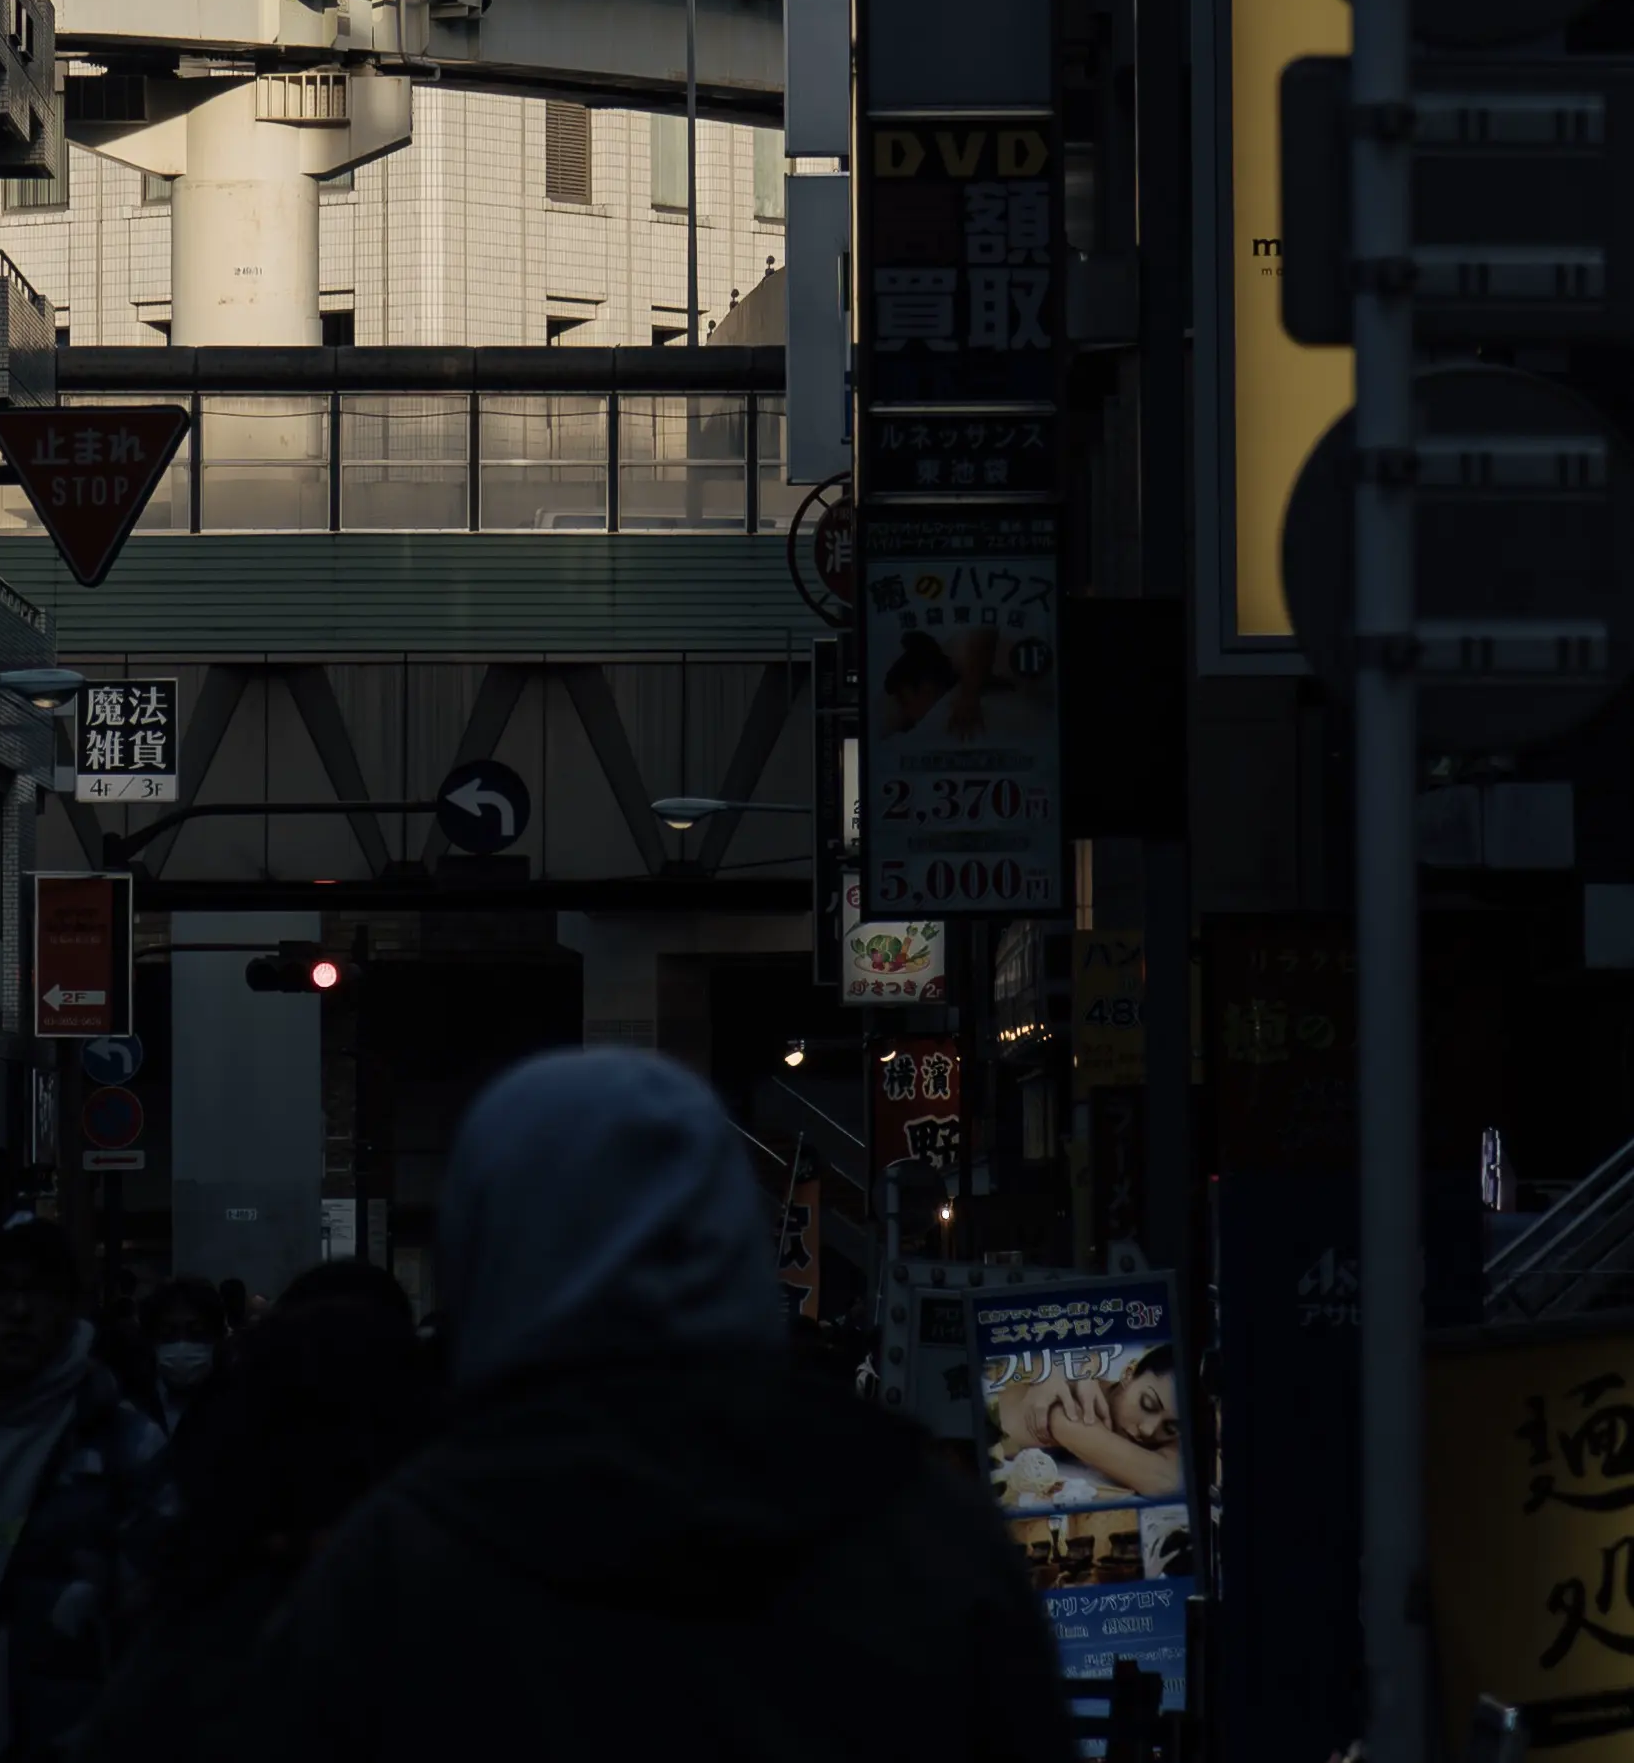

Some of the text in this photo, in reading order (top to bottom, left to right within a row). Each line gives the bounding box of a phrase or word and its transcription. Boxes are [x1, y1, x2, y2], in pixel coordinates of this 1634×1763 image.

[873, 130, 1050, 177] DVD
[873, 267, 1052, 352] 買取
[32, 427, 144, 466] 止まれ
[880, 423, 1045, 451] ルネッサンス
[51, 475, 129, 507] STOP
[85, 684, 168, 727] 魔法
[85, 729, 168, 771] 雑貨
[89, 778, 113, 797] 4F
[140, 778, 163, 797] 3F
[990, 1315, 1115, 1345] エステサロン
[983, 1343, 1124, 1391] プリモア
